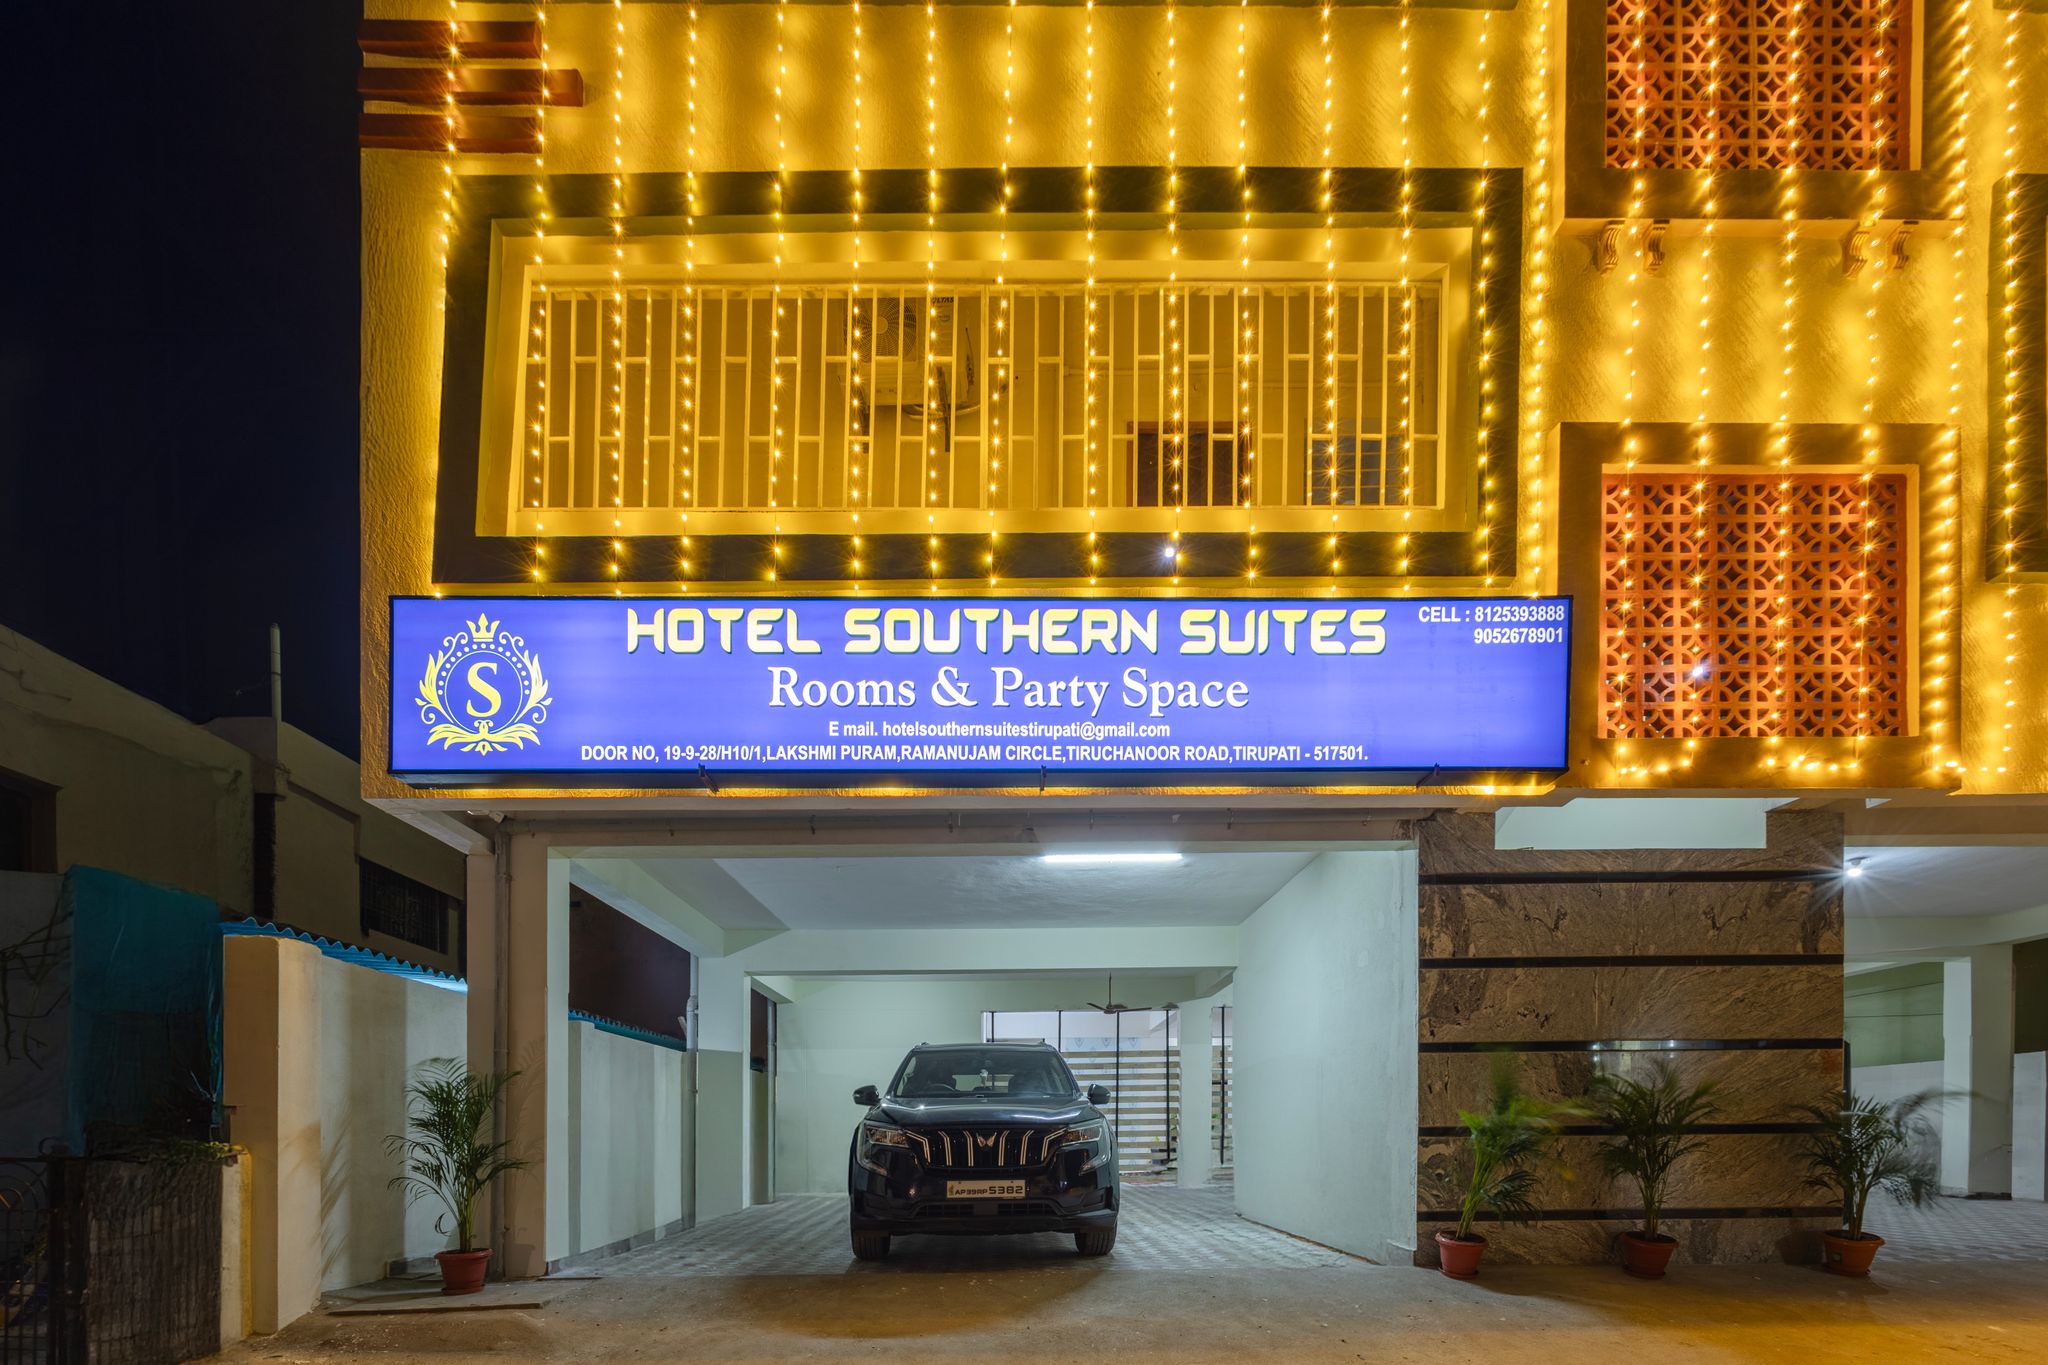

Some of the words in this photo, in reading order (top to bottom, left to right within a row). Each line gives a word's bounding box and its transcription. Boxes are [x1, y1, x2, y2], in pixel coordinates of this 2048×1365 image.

[1418, 606, 1461, 622] CELL
[1465, 609, 1470, 622] :
[1474, 606, 1564, 622] 8125393888
[627, 608, 822, 653] HOTEL
[843, 608, 1158, 654] SOUTHERN
[1179, 608, 1386, 654] SUITES
[1473, 627, 1563, 644] 9052678901
[466, 661, 502, 718] S
[768, 667, 916, 707] Rooms
[931, 666, 978, 707] &
[991, 667, 1110, 717] Party
[1122, 667, 1249, 717] Space
[828, 720, 839, 737] E
[843, 720, 879, 737] mail.
[882, 720, 1171, 741] hotelsouthernsuitestirupati@gmail.com
[581, 744, 628, 761] DOOR
[632, 744, 659, 763] NO,
[1313, 744, 1369, 761] 517501.
